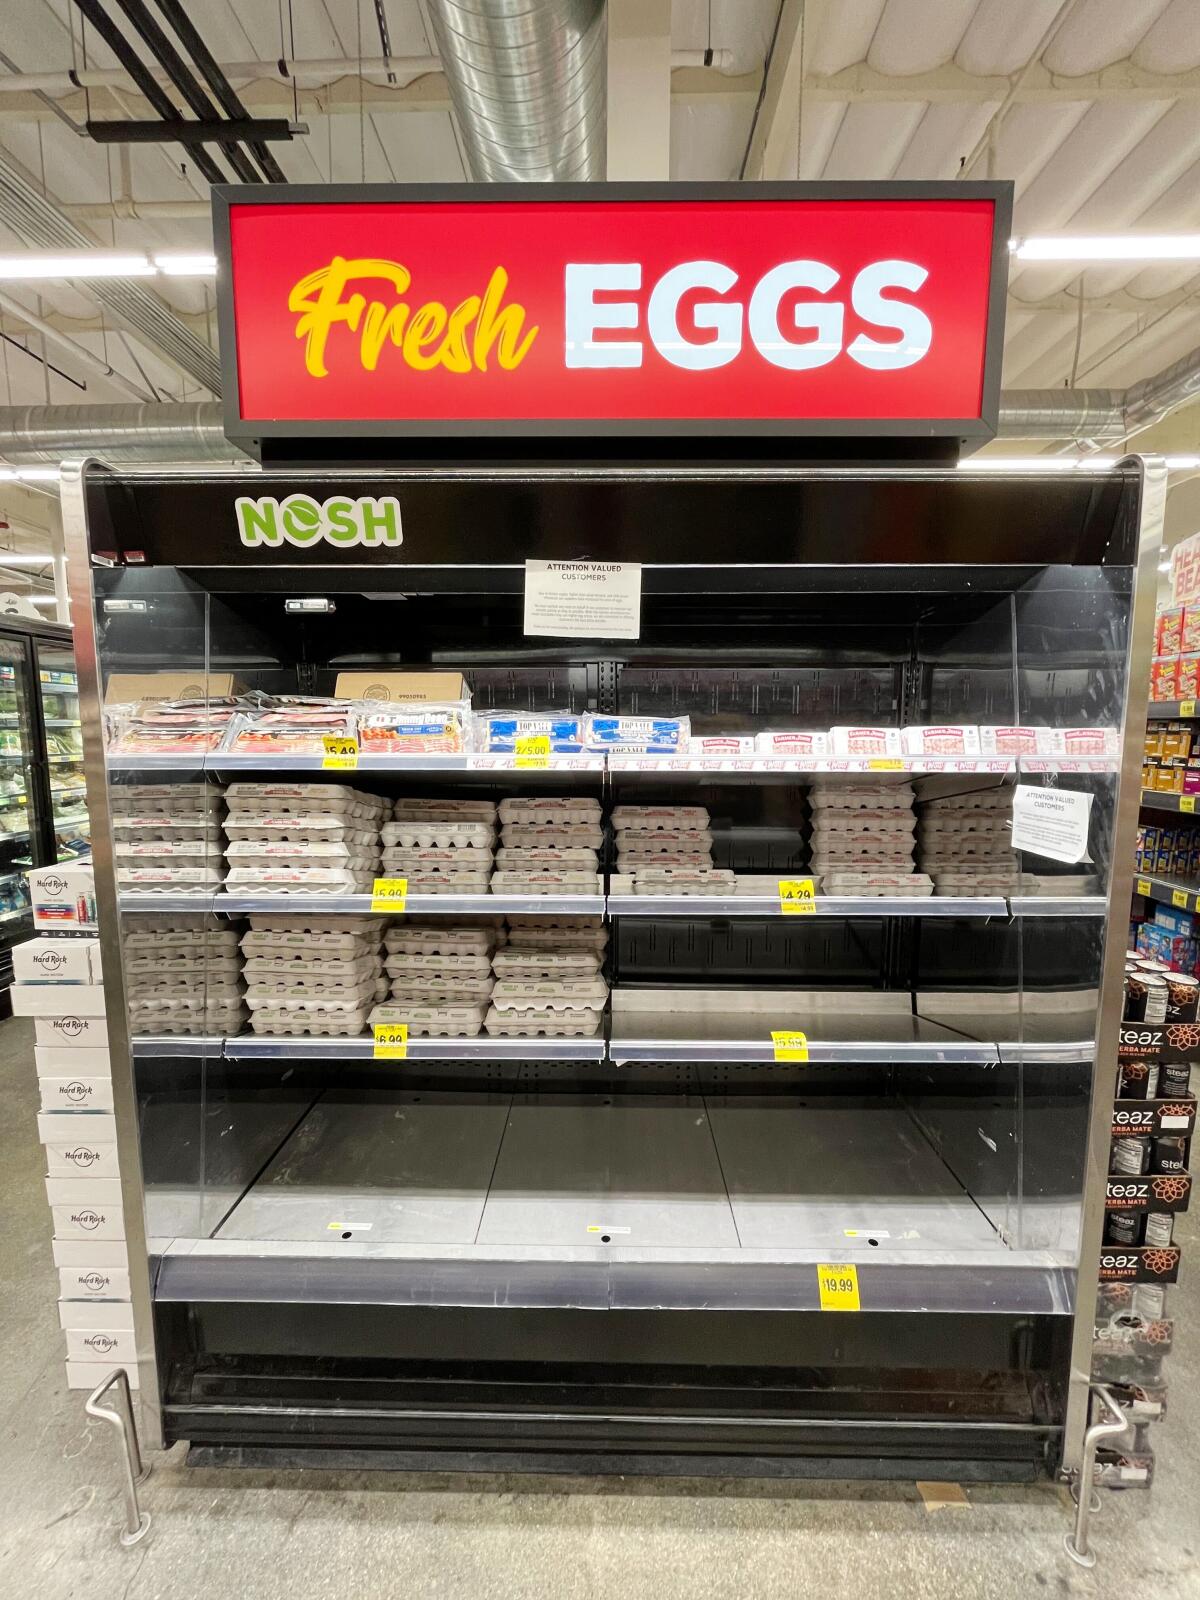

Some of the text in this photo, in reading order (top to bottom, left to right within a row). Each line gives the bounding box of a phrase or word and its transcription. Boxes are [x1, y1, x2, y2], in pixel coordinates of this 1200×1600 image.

[288, 255, 932, 378] Fresh EGGS
[240, 499, 398, 541] NOSH
[547, 563, 622, 572] ATTENTION VALUED
[561, 573, 607, 581] CUSTOMERS
[516, 746, 546, 755] 2/5.00
[1026, 791, 1075, 804] ATTENTION VALUED
[1034, 801, 1065, 812] CUSTOMERS
[53, 880, 68, 888] Rock
[33, 955, 67, 965] Hard Rock
[53, 1020, 89, 1030] Hard Rock
[1119, 1028, 1163, 1046] teaz
[1140, 1046, 1161, 1054] MATE
[59, 1086, 92, 1096] Hard Rock
[1112, 1110, 1154, 1125] teaz
[65, 1152, 100, 1162] Hard Rock
[1106, 1183, 1149, 1198] teaz
[71, 1215, 106, 1224] Hard Rock
[1098, 1255, 1139, 1268] teaz
[94, 1277, 110, 1286] Rock
[84, 1338, 118, 1348] Hard Rock
